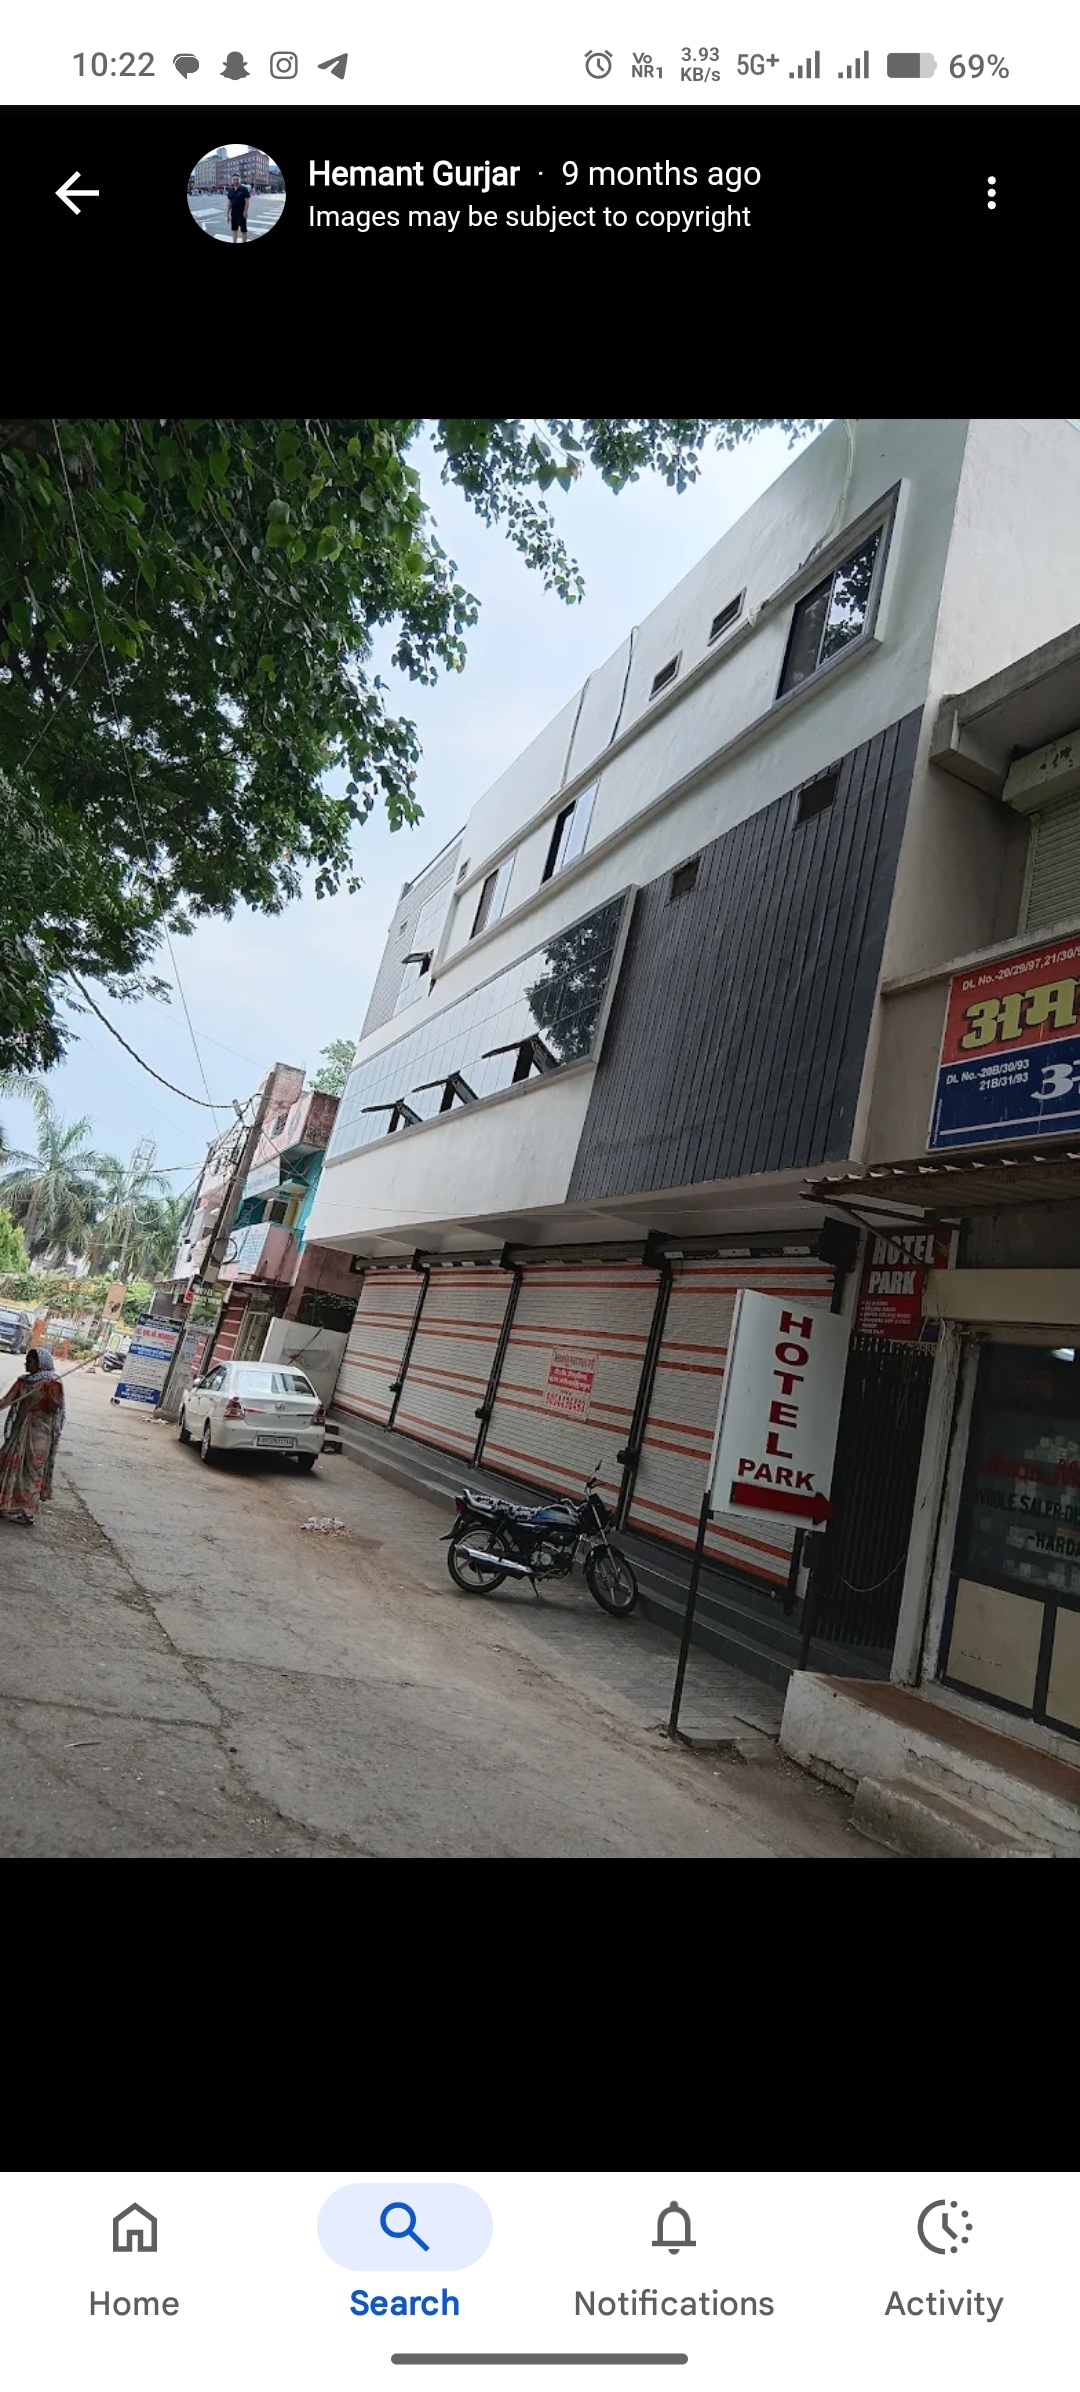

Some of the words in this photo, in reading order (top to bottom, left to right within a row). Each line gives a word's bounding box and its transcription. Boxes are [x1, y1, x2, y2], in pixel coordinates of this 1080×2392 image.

[962, 979, 976, 991] DL
[961, 976, 1080, 1049] अम
[946, 1073, 959, 1085] DL
[872, 1234, 935, 1266] HOTEL
[867, 1270, 917, 1295] PARK
[765, 1310, 814, 1460] HOTEL
[737, 1457, 817, 1492] PARK
